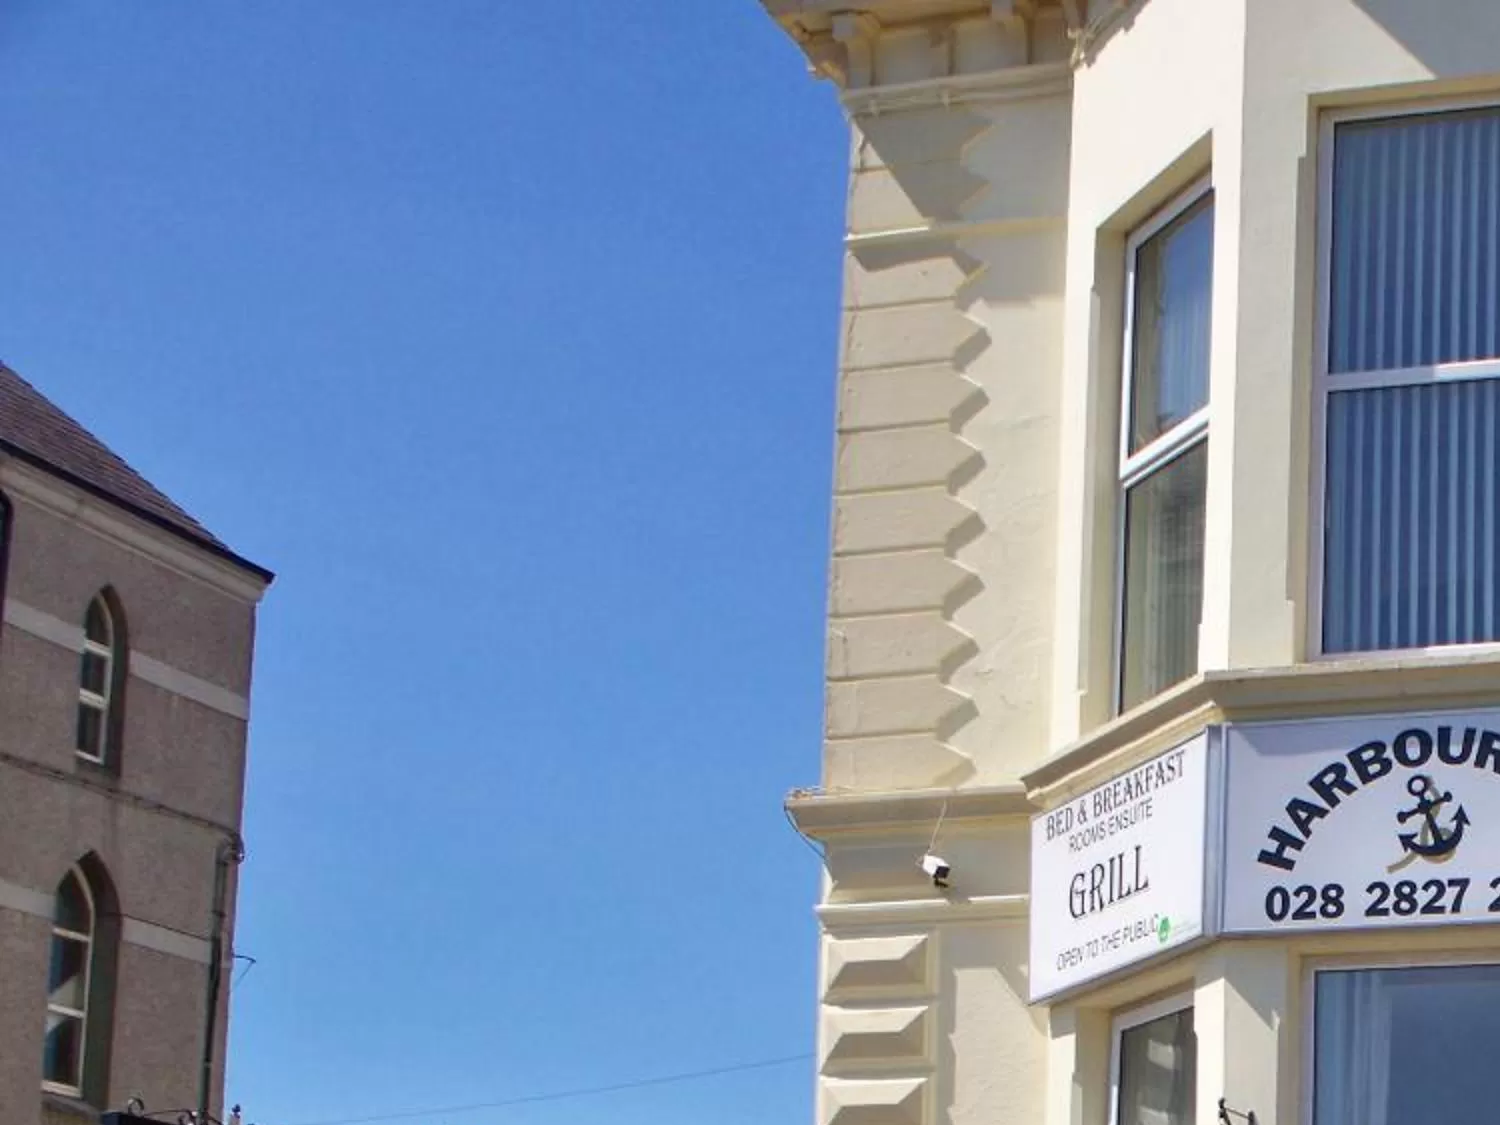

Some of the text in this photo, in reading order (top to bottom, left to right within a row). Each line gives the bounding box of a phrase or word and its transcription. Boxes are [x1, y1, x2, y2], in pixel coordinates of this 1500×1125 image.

[1046, 750, 1186, 841] BED & BREAKFAST
[1069, 798, 1153, 853] ROOMS ENSUITE
[1069, 845, 1149, 919] GRILL
[1265, 882, 1345, 922] 028
[1365, 877, 1470, 917] 2827
[1057, 946, 1084, 971] OPEN
[1086, 941, 1100, 962] TO
[1101, 932, 1121, 954] THE
[1122, 913, 1160, 945] PUBLIC
